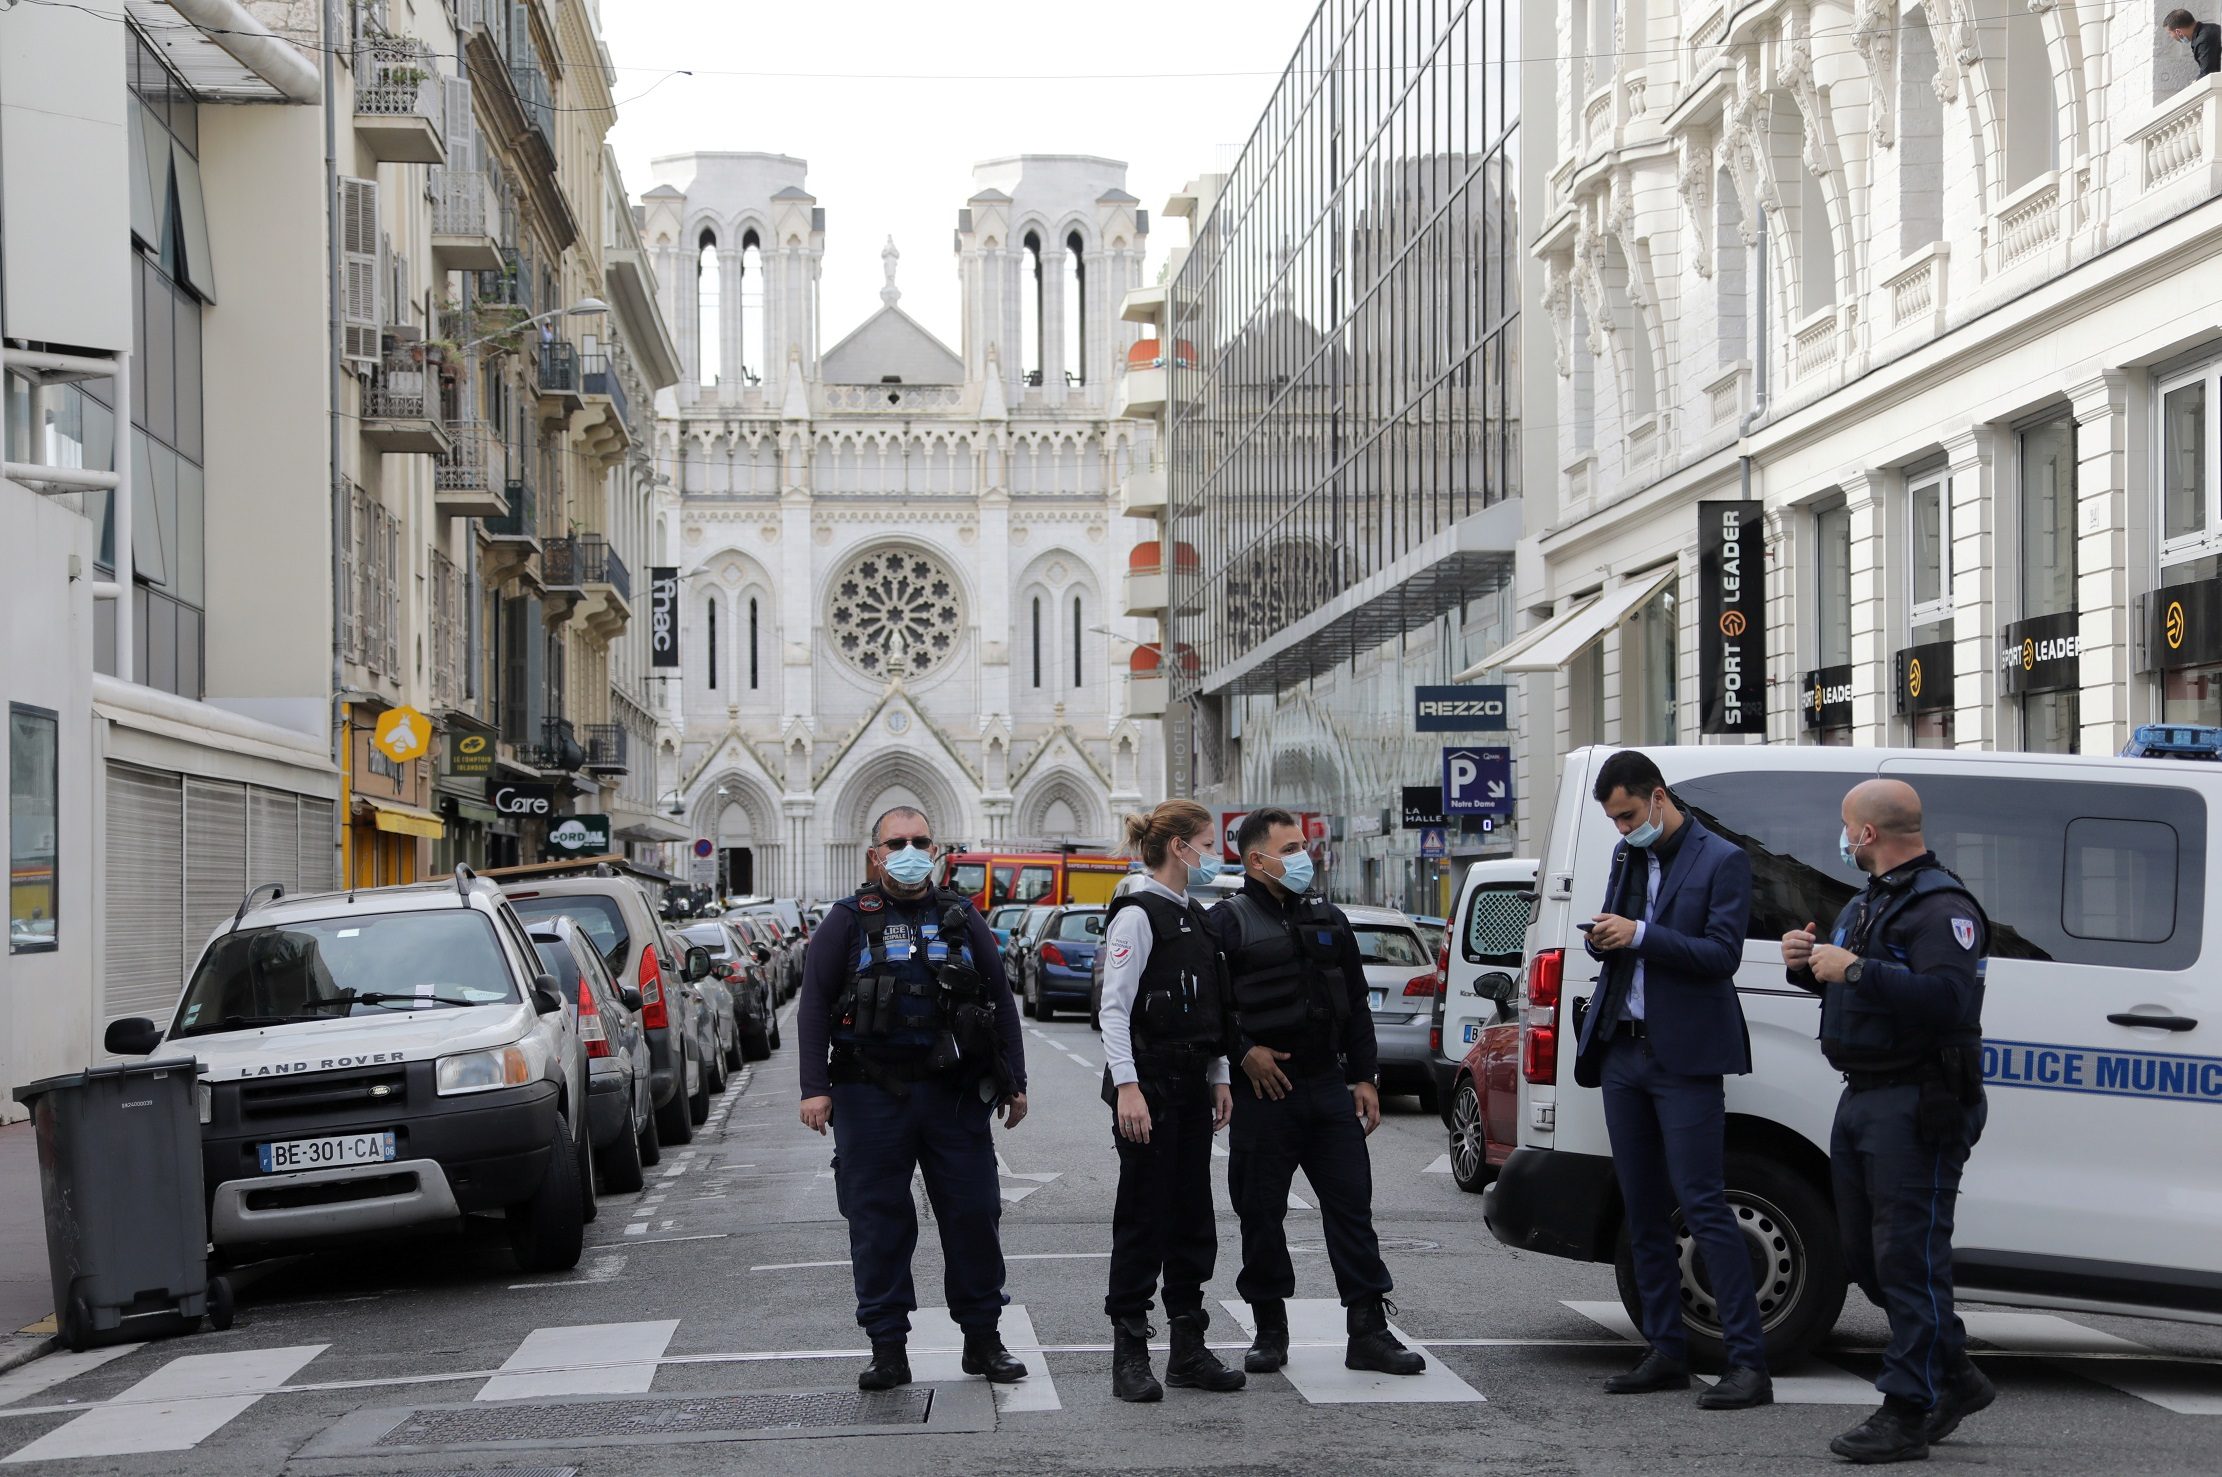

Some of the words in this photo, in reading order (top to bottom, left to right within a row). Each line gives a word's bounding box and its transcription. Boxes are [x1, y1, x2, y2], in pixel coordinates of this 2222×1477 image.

[1723, 510, 1740, 603] LEADER
[653, 579, 677, 652] fnac
[1724, 642, 1742, 725] SPORT
[1822, 684, 1853, 704] LEADE
[1419, 701, 1503, 716] REZZO
[1174, 716, 1185, 766] HOTEL
[1450, 759, 1477, 799] P
[496, 787, 549, 814] Care
[1405, 807, 1420, 815] LA
[1451, 800, 1473, 808] Notre
[1474, 800, 1496, 808] Dame
[1482, 820, 1492, 831] 0
[884, 926, 906, 936] LICE
[241, 1062, 308, 1078] LAND
[321, 1052, 405, 1069] ROVER
[1980, 1046, 2084, 1086] OLICE
[2096, 1055, 2222, 1097] MUNIC
